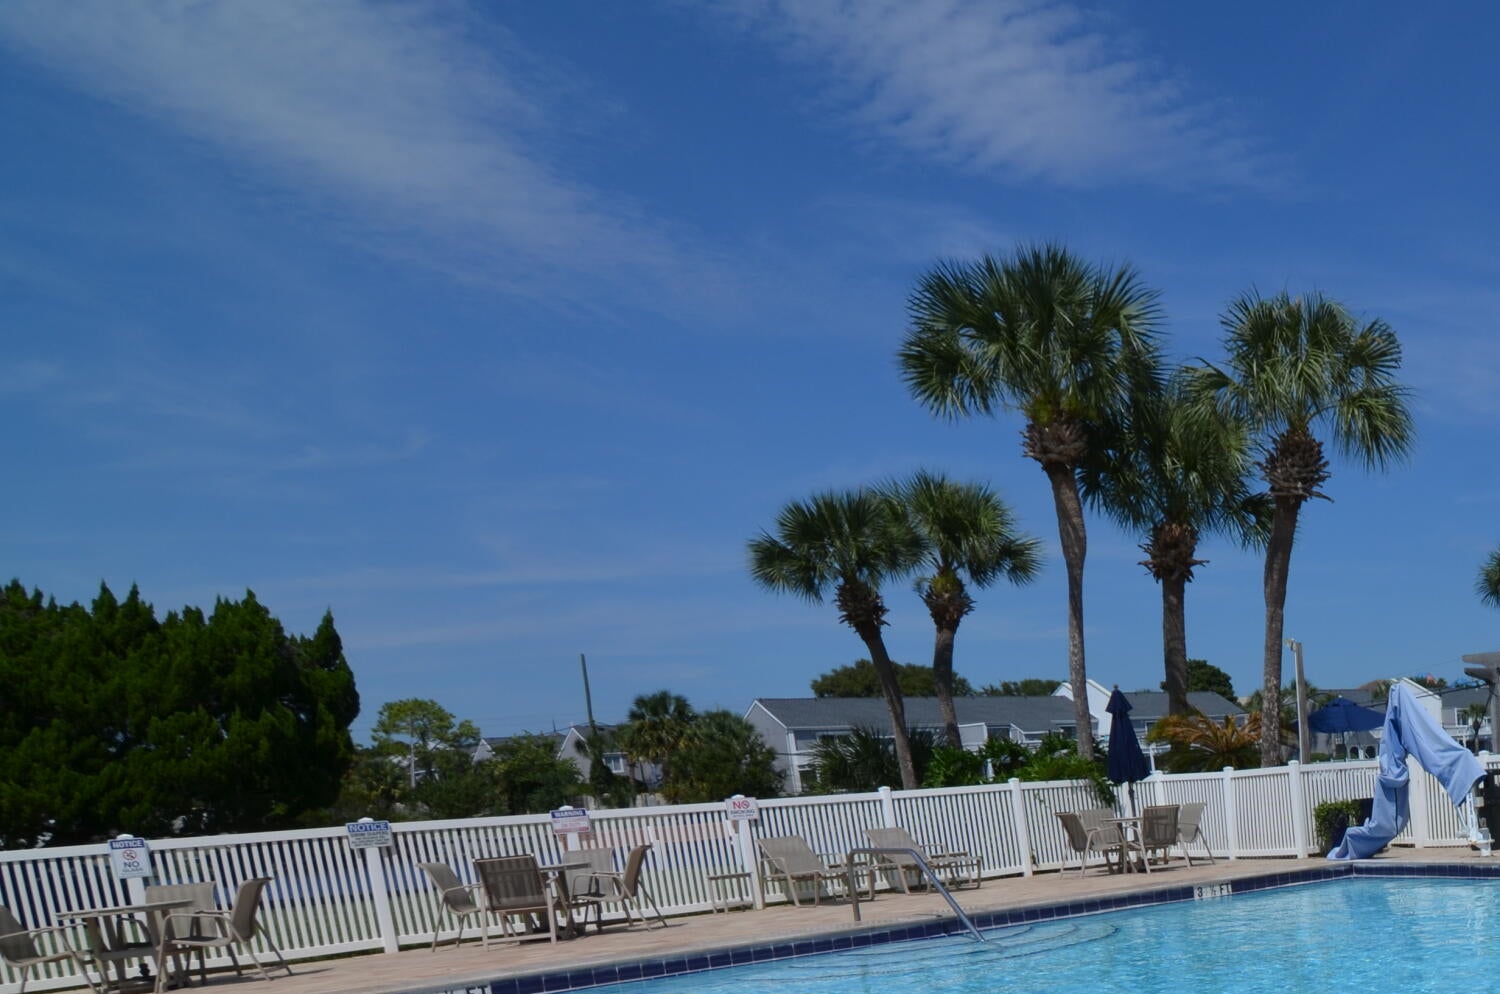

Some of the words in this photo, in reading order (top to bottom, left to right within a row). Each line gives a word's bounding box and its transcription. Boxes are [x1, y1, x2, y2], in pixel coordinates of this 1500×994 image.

[349, 822, 387, 832] NOTICE
[112, 840, 143, 848] NOTICE
[1197, 886, 1203, 897] 3
